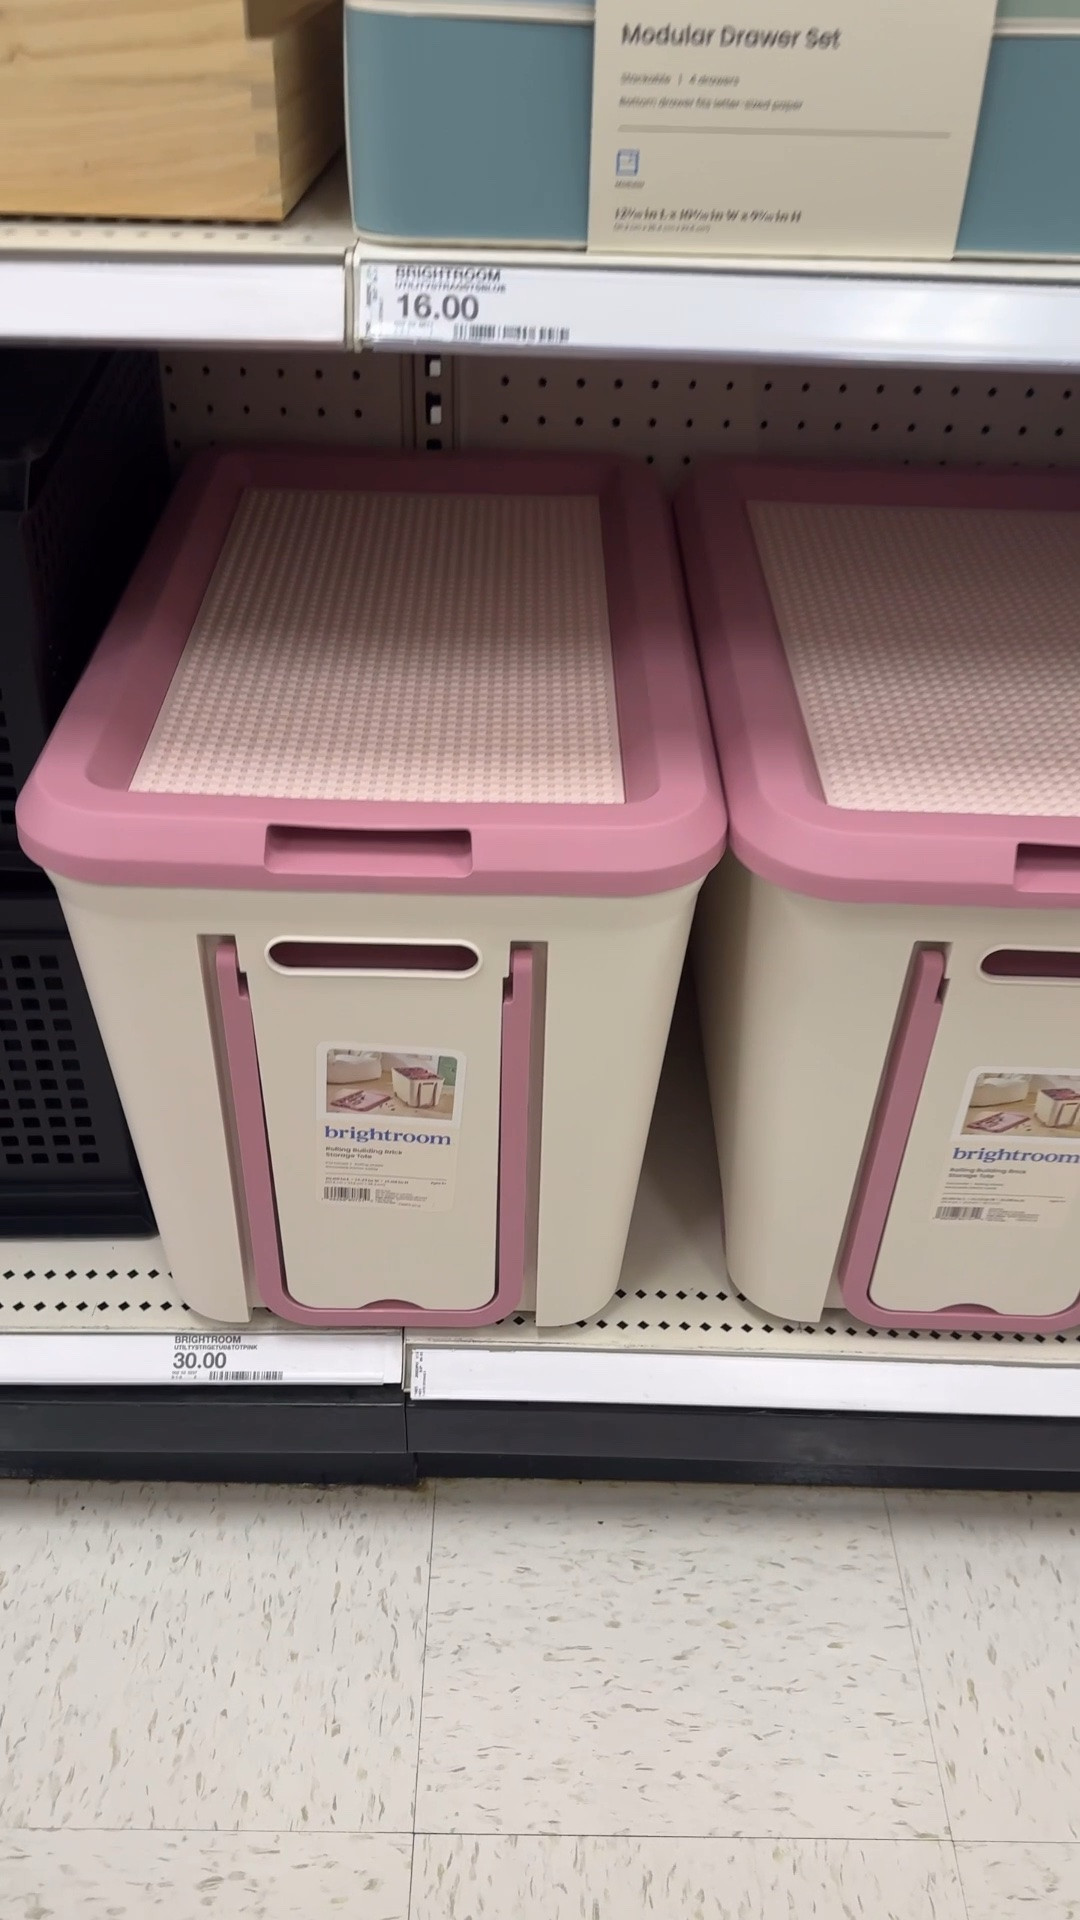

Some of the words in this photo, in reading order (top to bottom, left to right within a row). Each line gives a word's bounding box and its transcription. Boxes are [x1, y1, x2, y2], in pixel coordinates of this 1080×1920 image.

[621, 23, 715, 46] Modular
[720, 25, 801, 48] Drawer
[805, 27, 842, 50] Set
[396, 266, 500, 281] BRIGHTROOM
[398, 293, 478, 320] 16.00
[325, 1126, 451, 1145] brightroom
[953, 1148, 1080, 1163] brightroom
[173, 1352, 227, 1369] 30.00
